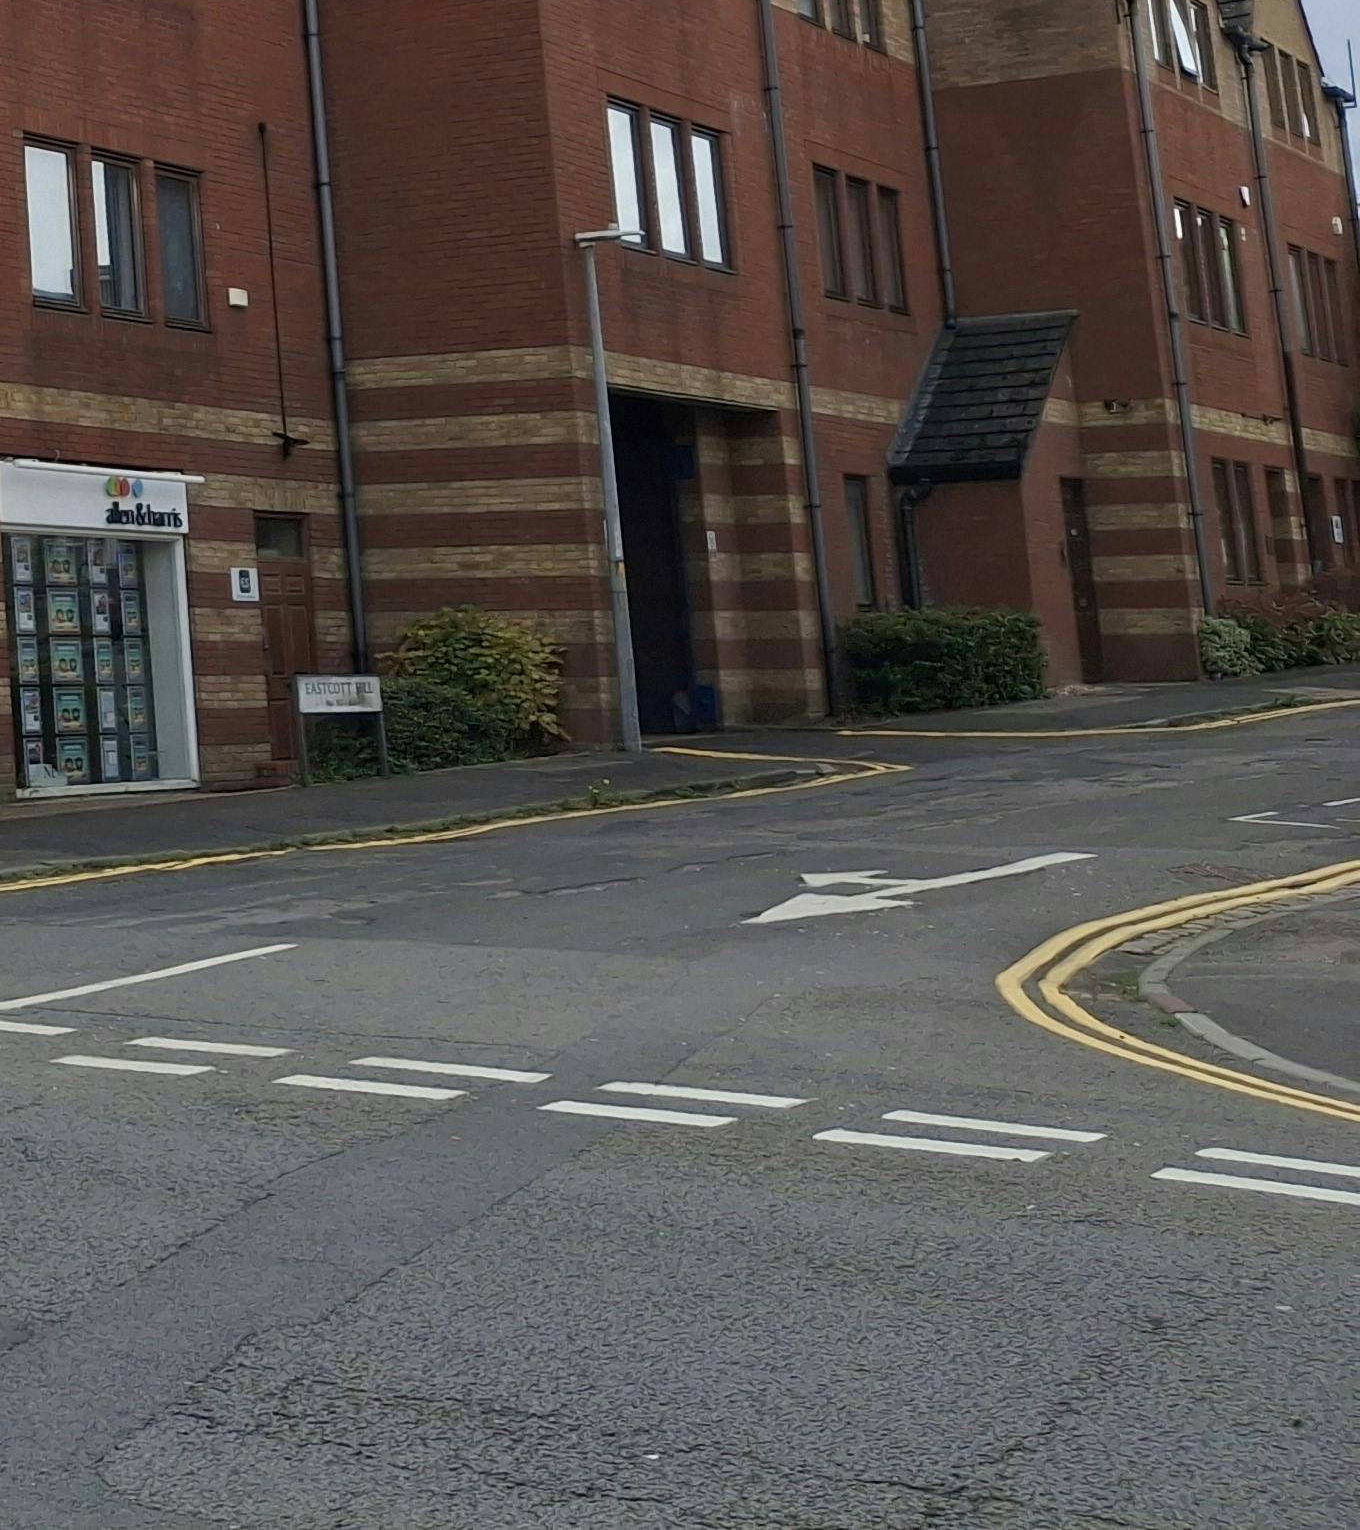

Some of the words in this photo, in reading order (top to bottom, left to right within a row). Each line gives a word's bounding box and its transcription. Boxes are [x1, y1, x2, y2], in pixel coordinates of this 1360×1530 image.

[106, 501, 135, 524] allen
[304, 682, 352, 695] EASTCOTT
[355, 682, 374, 694] HILL
